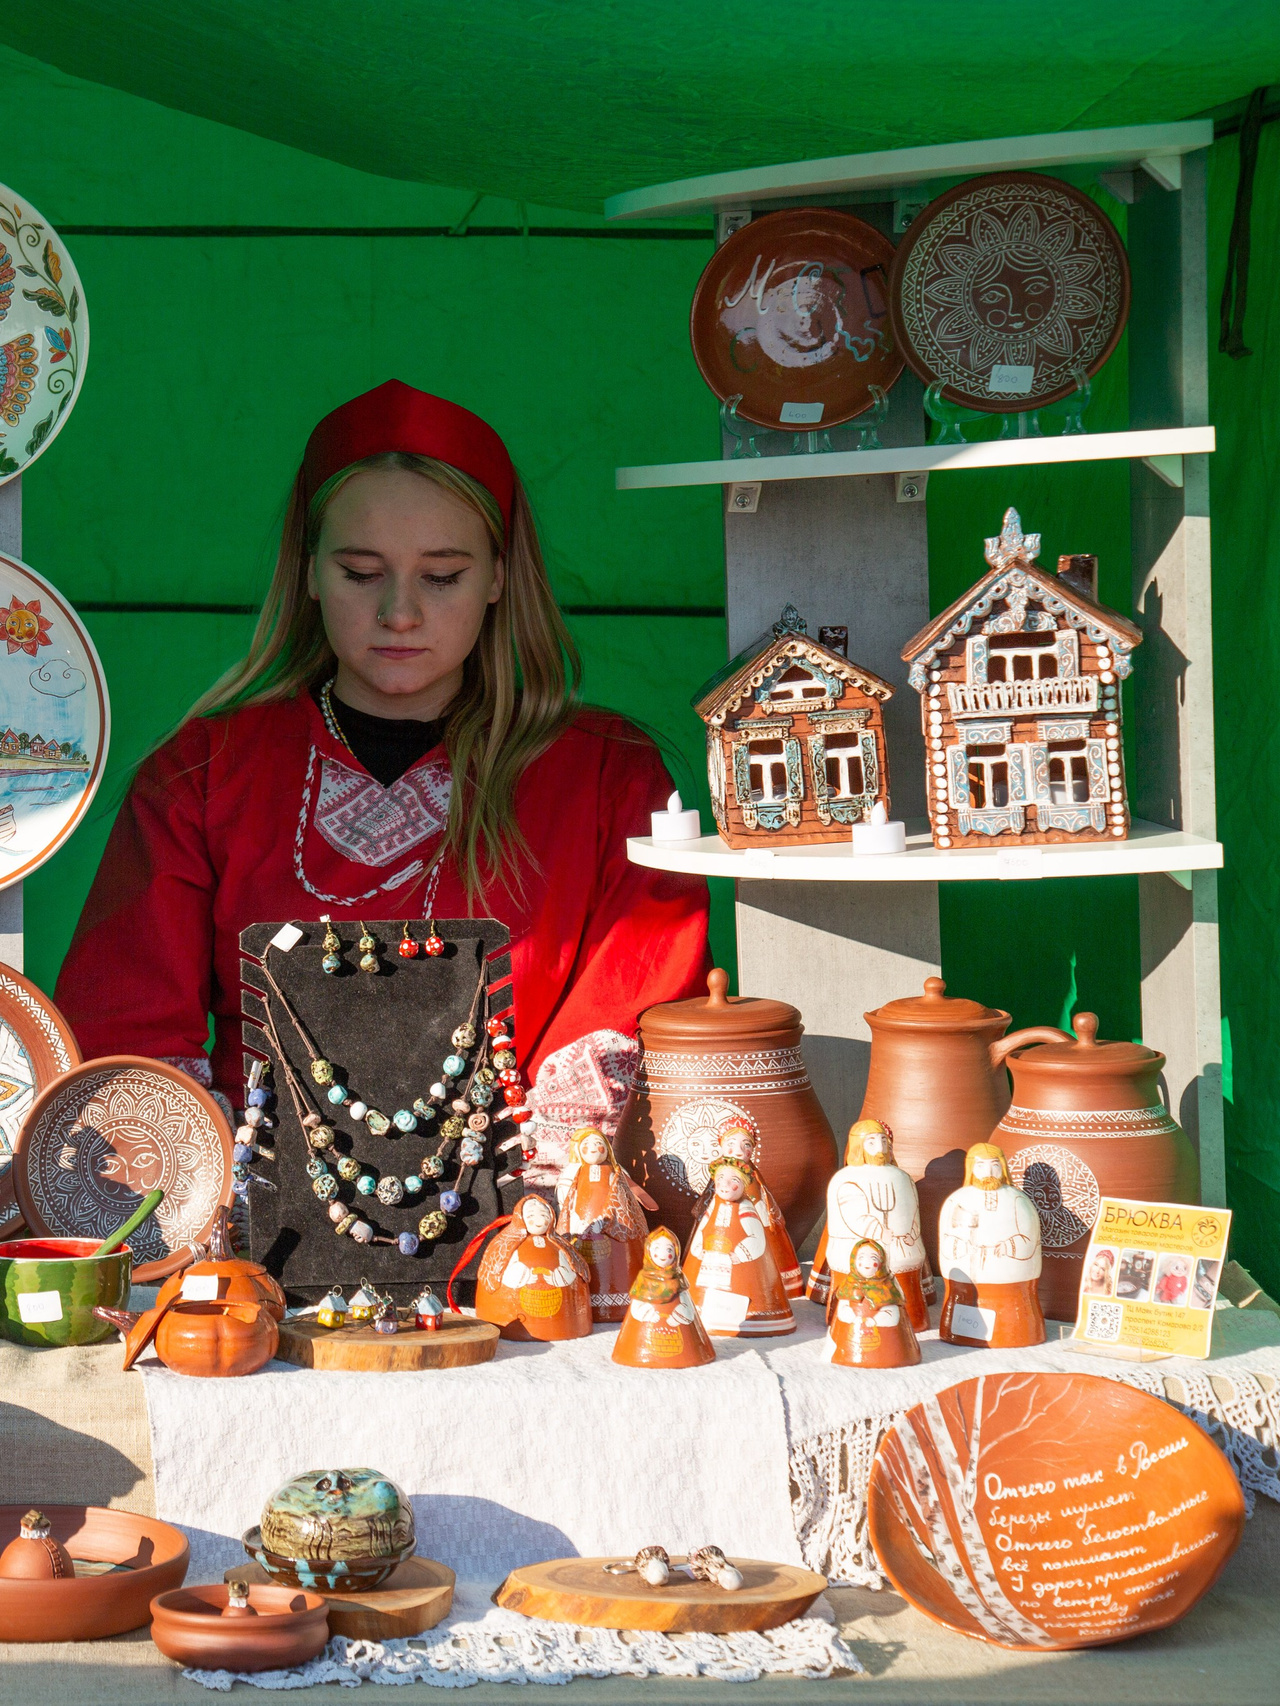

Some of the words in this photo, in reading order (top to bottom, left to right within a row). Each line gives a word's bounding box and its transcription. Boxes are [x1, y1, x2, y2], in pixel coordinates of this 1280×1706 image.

[996, 373, 1019, 385] 800
[1104, 1206, 1183, 1231] БРЮКВА
[1101, 1226, 1130, 1234] Магазин
[1130, 1230, 1159, 1238] товаров
[1159, 1232, 1185, 1241] ручной
[1159, 1243, 1194, 1251] мастеров
[1124, 1316, 1156, 1326] проспект
[1157, 1319, 1192, 1330] Комарова
[1135, 1306, 1153, 1315] Маяк
[1174, 1311, 1186, 1319] 147
[984, 1472, 1056, 1501] Отчего
[1063, 1469, 1104, 1490] так
[1115, 1454, 1128, 1475] в
[1129, 1436, 1189, 1479] России
[988, 1505, 1053, 1535] березы
[1060, 1490, 1136, 1530] шумят
[995, 1533, 1073, 1552] Отчего
[1081, 1489, 1209, 1546] белоствольные
[1001, 1556, 1030, 1572] всё
[1042, 1545, 1147, 1571] понимают
[1031, 1577, 1092, 1599] дорог,
[1094, 1531, 1219, 1588] прислонившись
[1020, 1600, 1041, 1608] по
[1052, 1593, 1112, 1609] ветру
[1123, 1570, 1181, 1596] стоят
[1138, 1588, 1176, 1607] так
